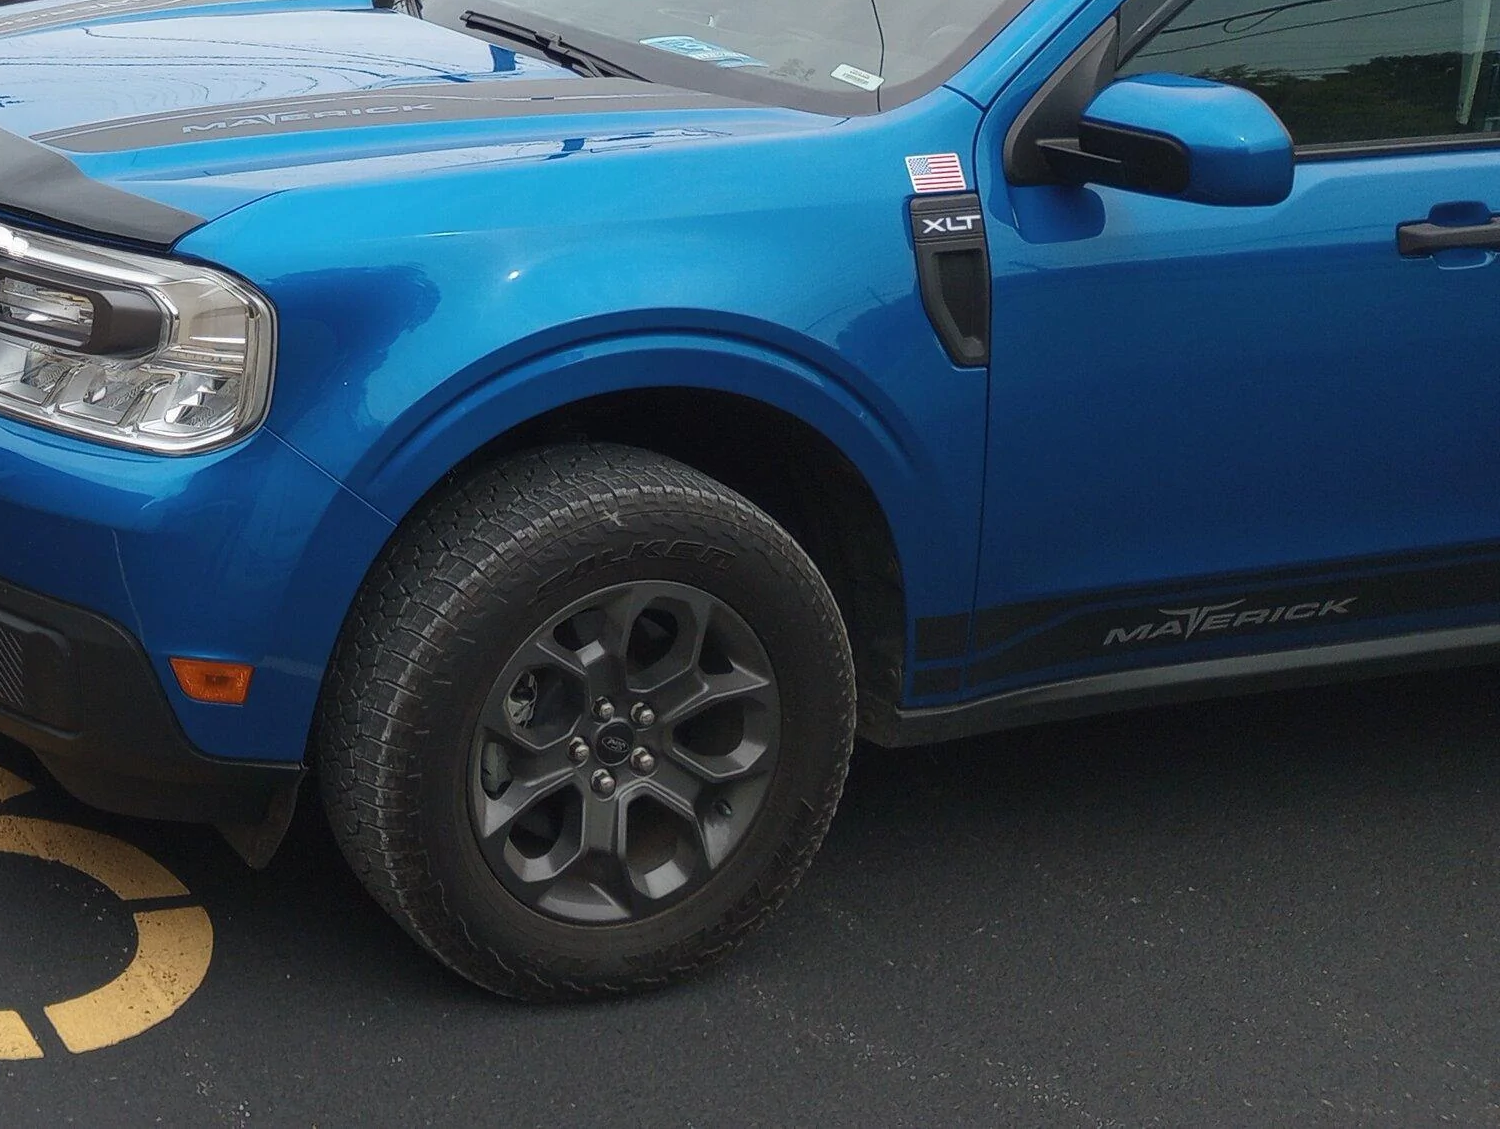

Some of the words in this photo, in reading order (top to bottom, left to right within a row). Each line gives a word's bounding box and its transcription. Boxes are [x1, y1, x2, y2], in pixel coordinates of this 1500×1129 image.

[182, 104, 435, 134] MAVERICK
[922, 214, 981, 234] XLT
[1103, 597, 1359, 647] MAVERICK
